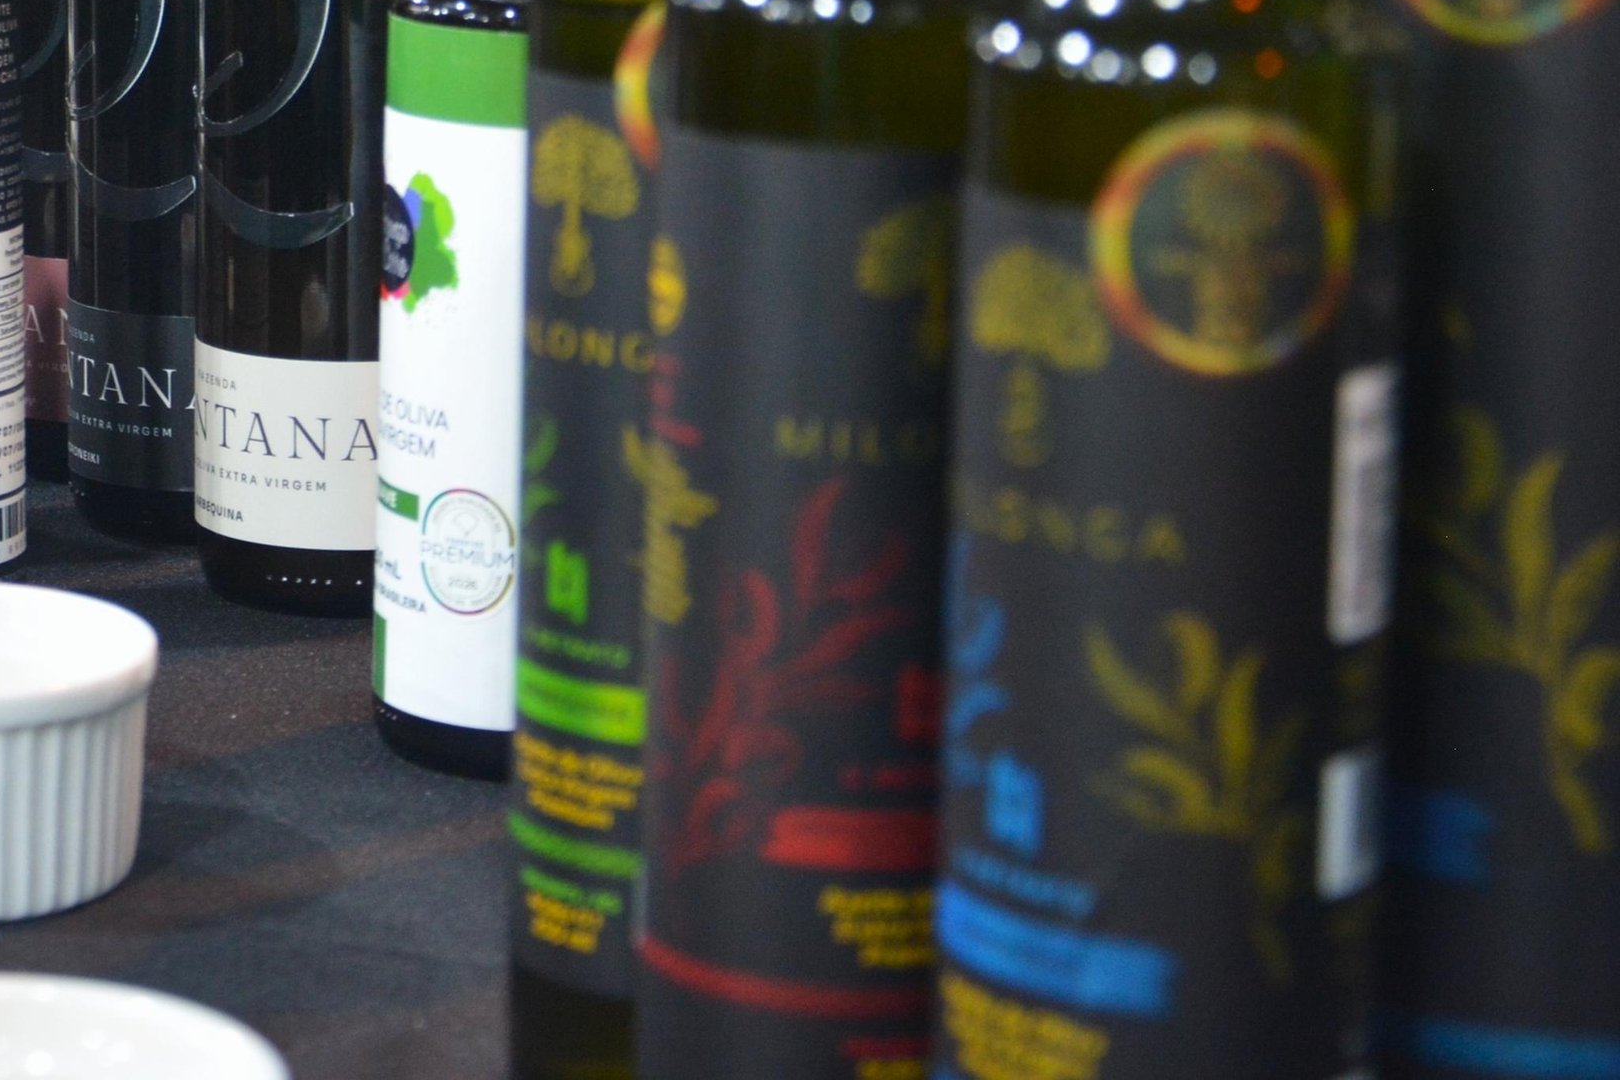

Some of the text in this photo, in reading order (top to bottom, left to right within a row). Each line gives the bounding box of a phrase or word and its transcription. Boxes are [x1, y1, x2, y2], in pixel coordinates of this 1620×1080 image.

[198, 368, 237, 390] FAZENDA
[81, 414, 113, 430] EXTRA
[118, 423, 172, 438] VIRGEM
[396, 397, 449, 431] OLIVA
[220, 467, 257, 486] EXTRA
[265, 477, 327, 492] VIRGEM
[195, 494, 243, 522] ARBEQUINA
[420, 540, 515, 569] PREMIUM
